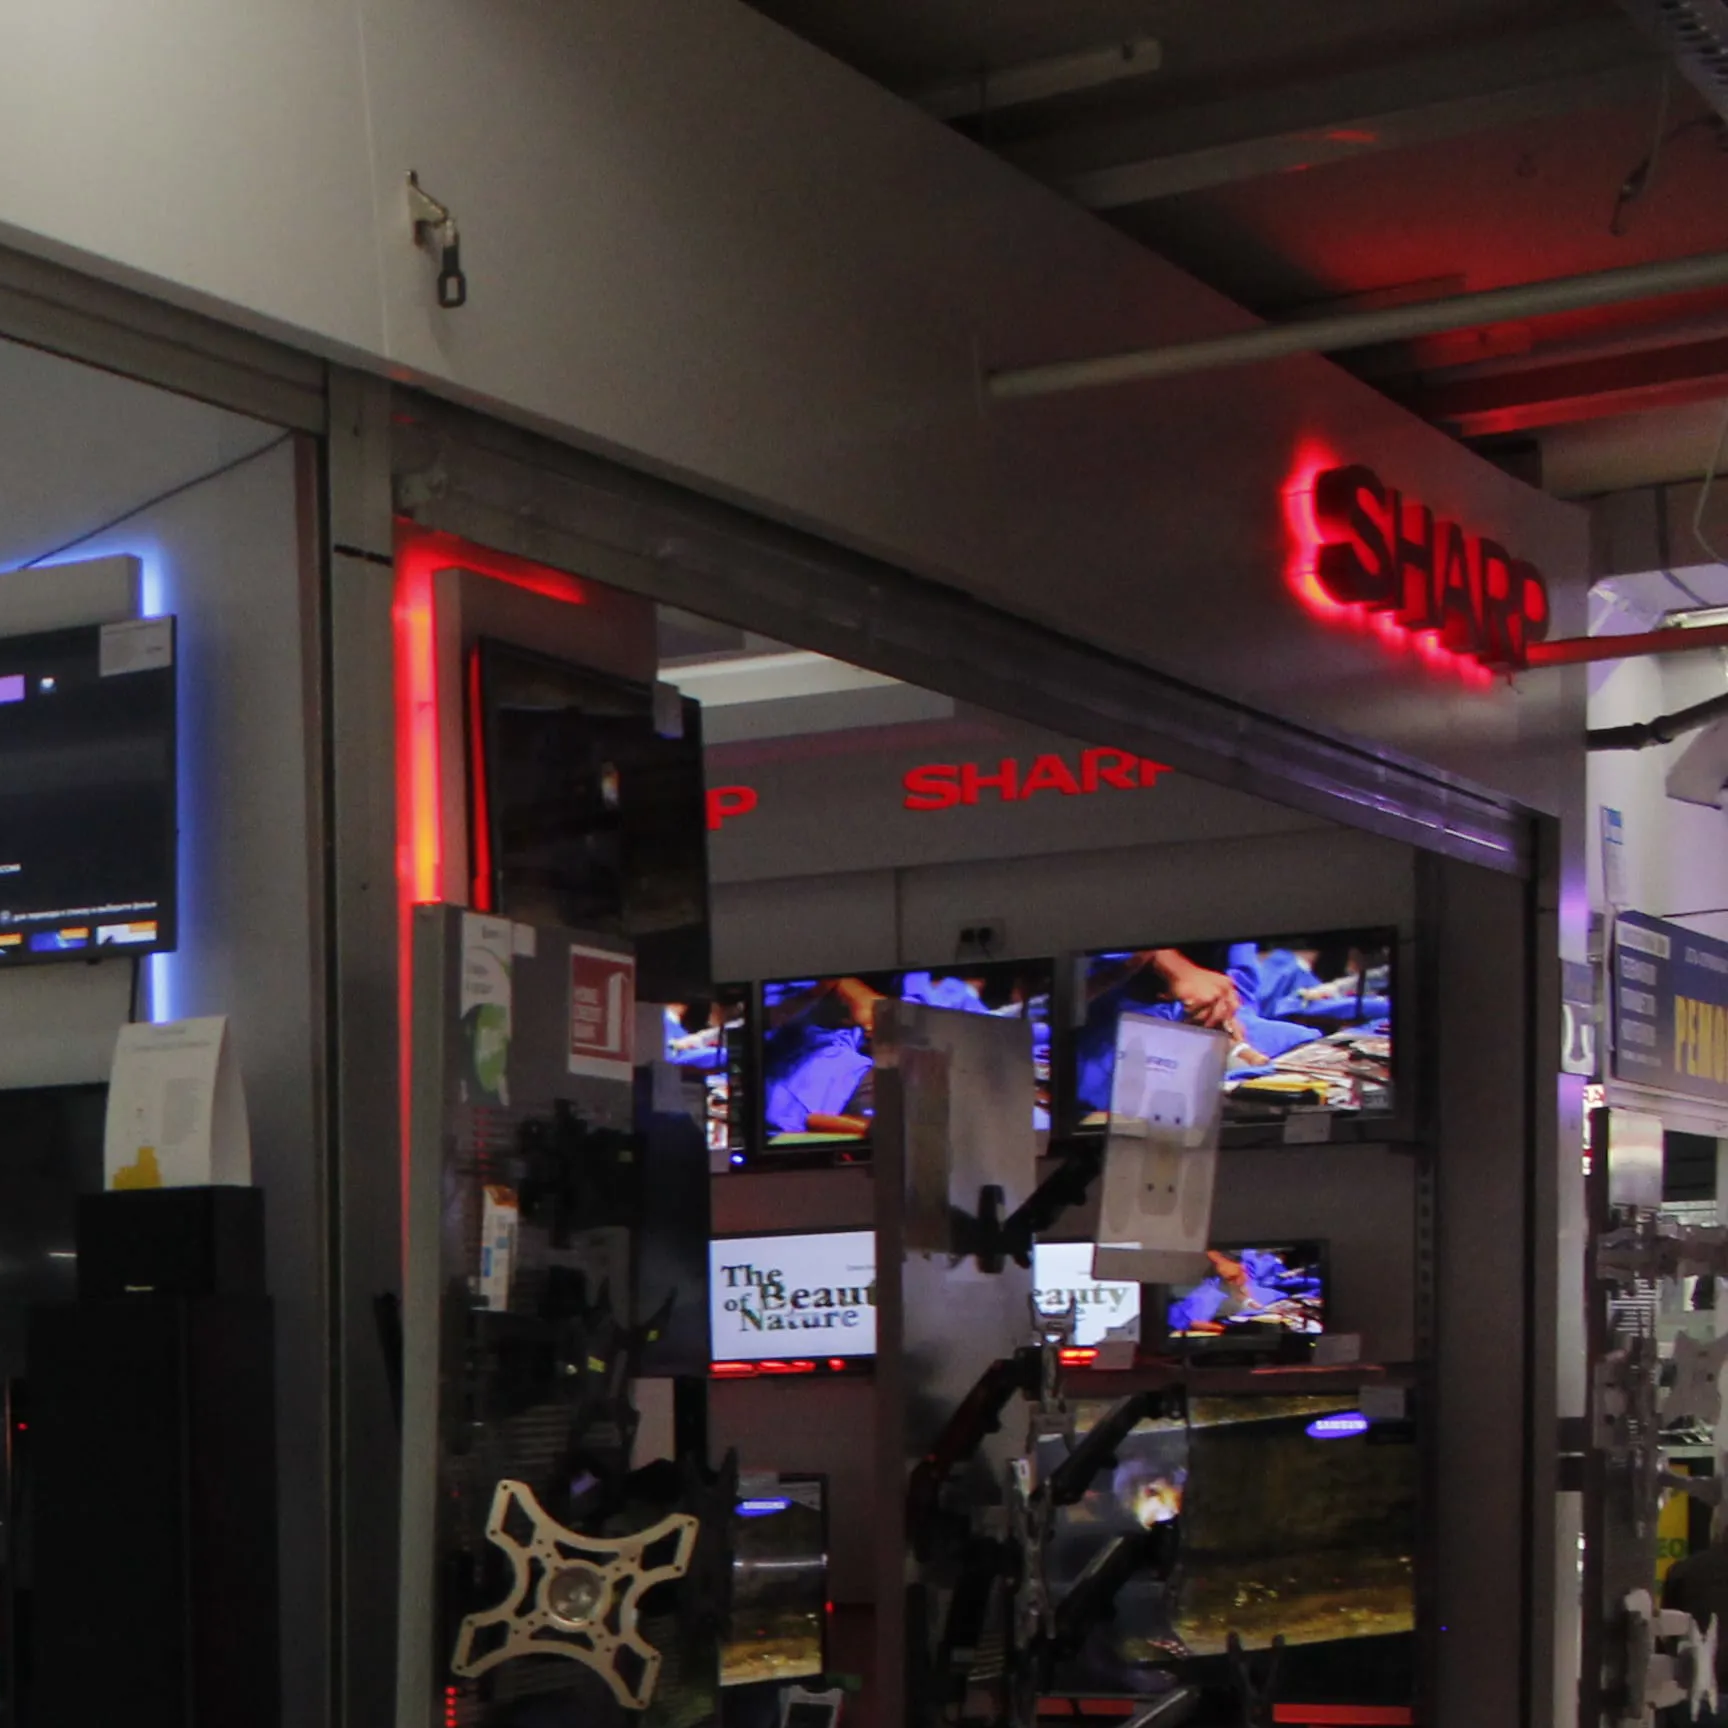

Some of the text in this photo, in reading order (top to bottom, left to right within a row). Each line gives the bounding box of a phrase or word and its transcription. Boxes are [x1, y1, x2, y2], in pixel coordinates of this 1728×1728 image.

[1316, 464, 1548, 672] SHARP
[721, 1263, 783, 1288] The
[759, 1279, 876, 1311] Beaut
[1033, 1281, 1128, 1313] eauty
[739, 1306, 858, 1333] Nature
